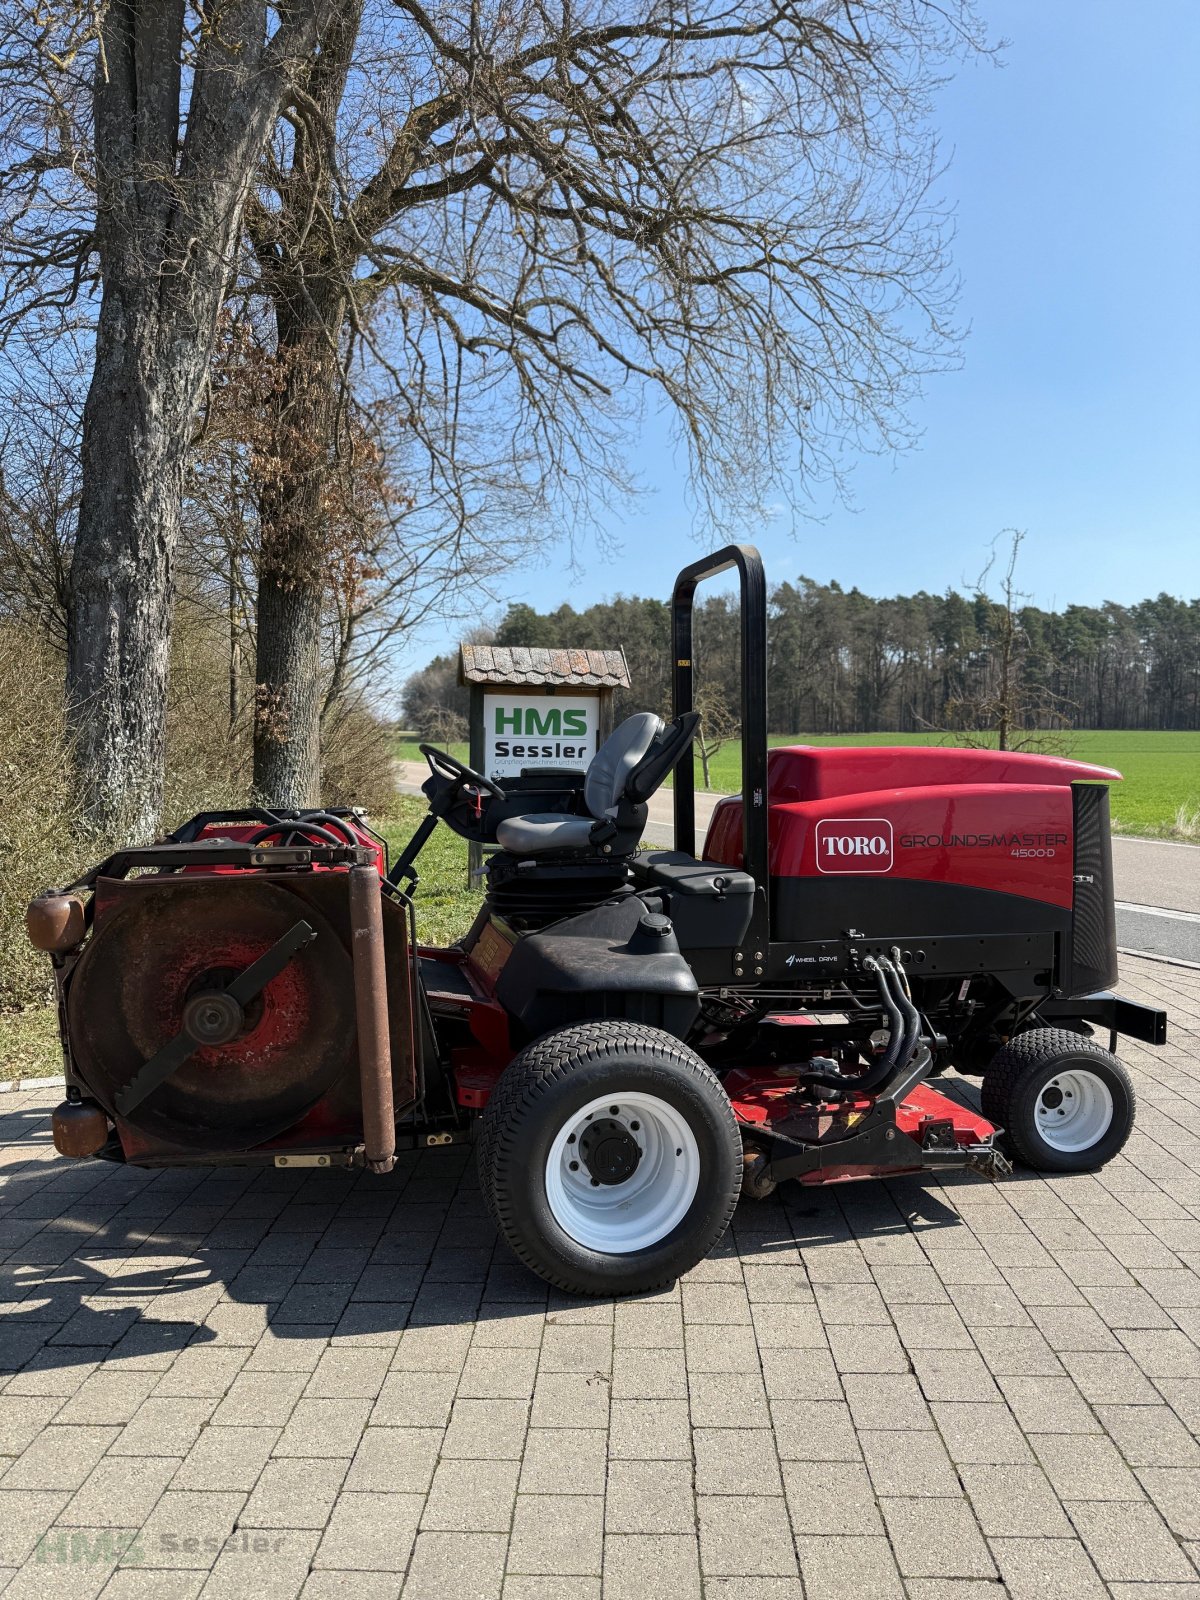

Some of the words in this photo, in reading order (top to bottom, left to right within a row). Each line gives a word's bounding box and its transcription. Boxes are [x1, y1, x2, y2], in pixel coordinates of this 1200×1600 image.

[495, 708, 587, 736] HMS
[495, 742, 587, 758] Sessler
[822, 836, 886, 856] TORO
[900, 834, 1068, 848] GROUNDSMASTER
[785, 954, 796, 967] 4
